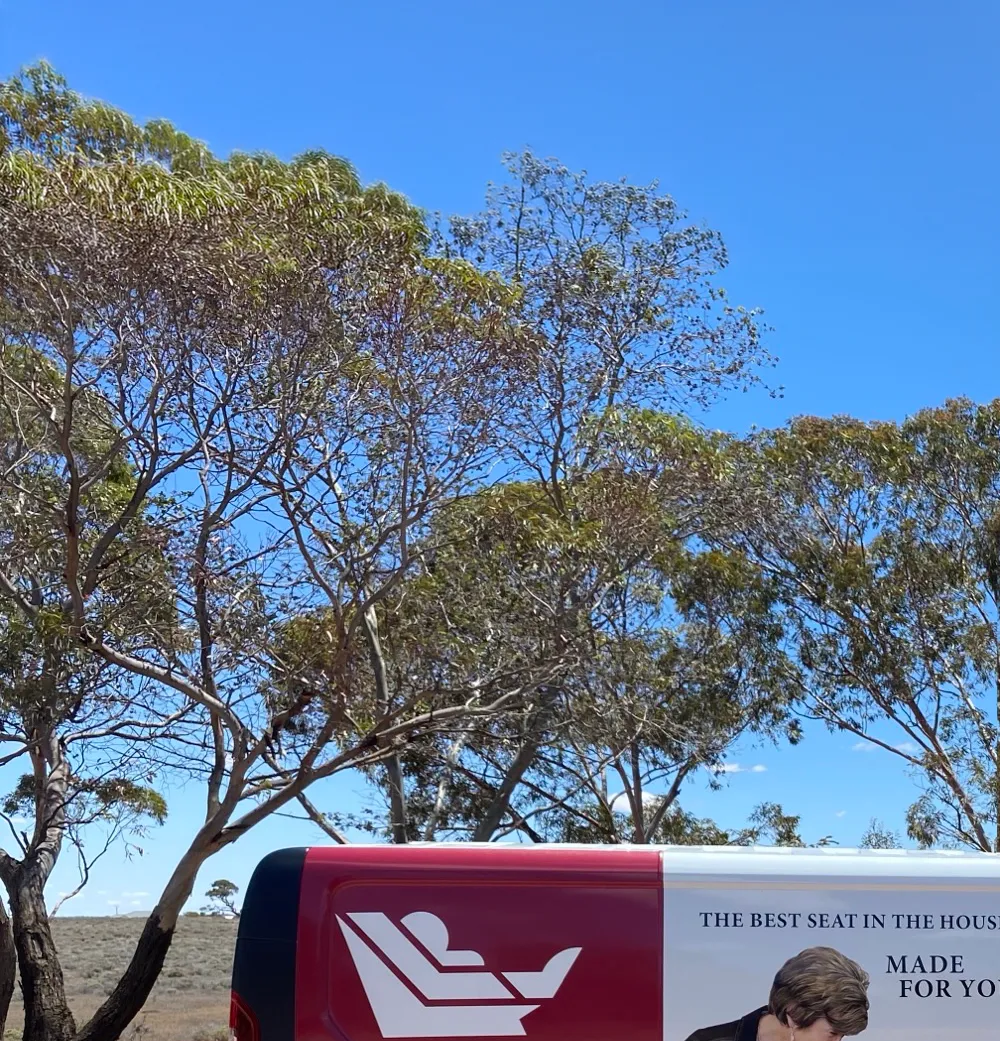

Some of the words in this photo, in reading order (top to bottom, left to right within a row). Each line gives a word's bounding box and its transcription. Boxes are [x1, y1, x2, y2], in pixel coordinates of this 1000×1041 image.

[699, 911, 744, 928] THE
[750, 911, 802, 929] BEST
[807, 912, 858, 929] SEAT
[863, 913, 886, 930] IN
[892, 913, 934, 930] THE
[886, 954, 965, 974] MADE
[899, 979, 951, 998] FOR
